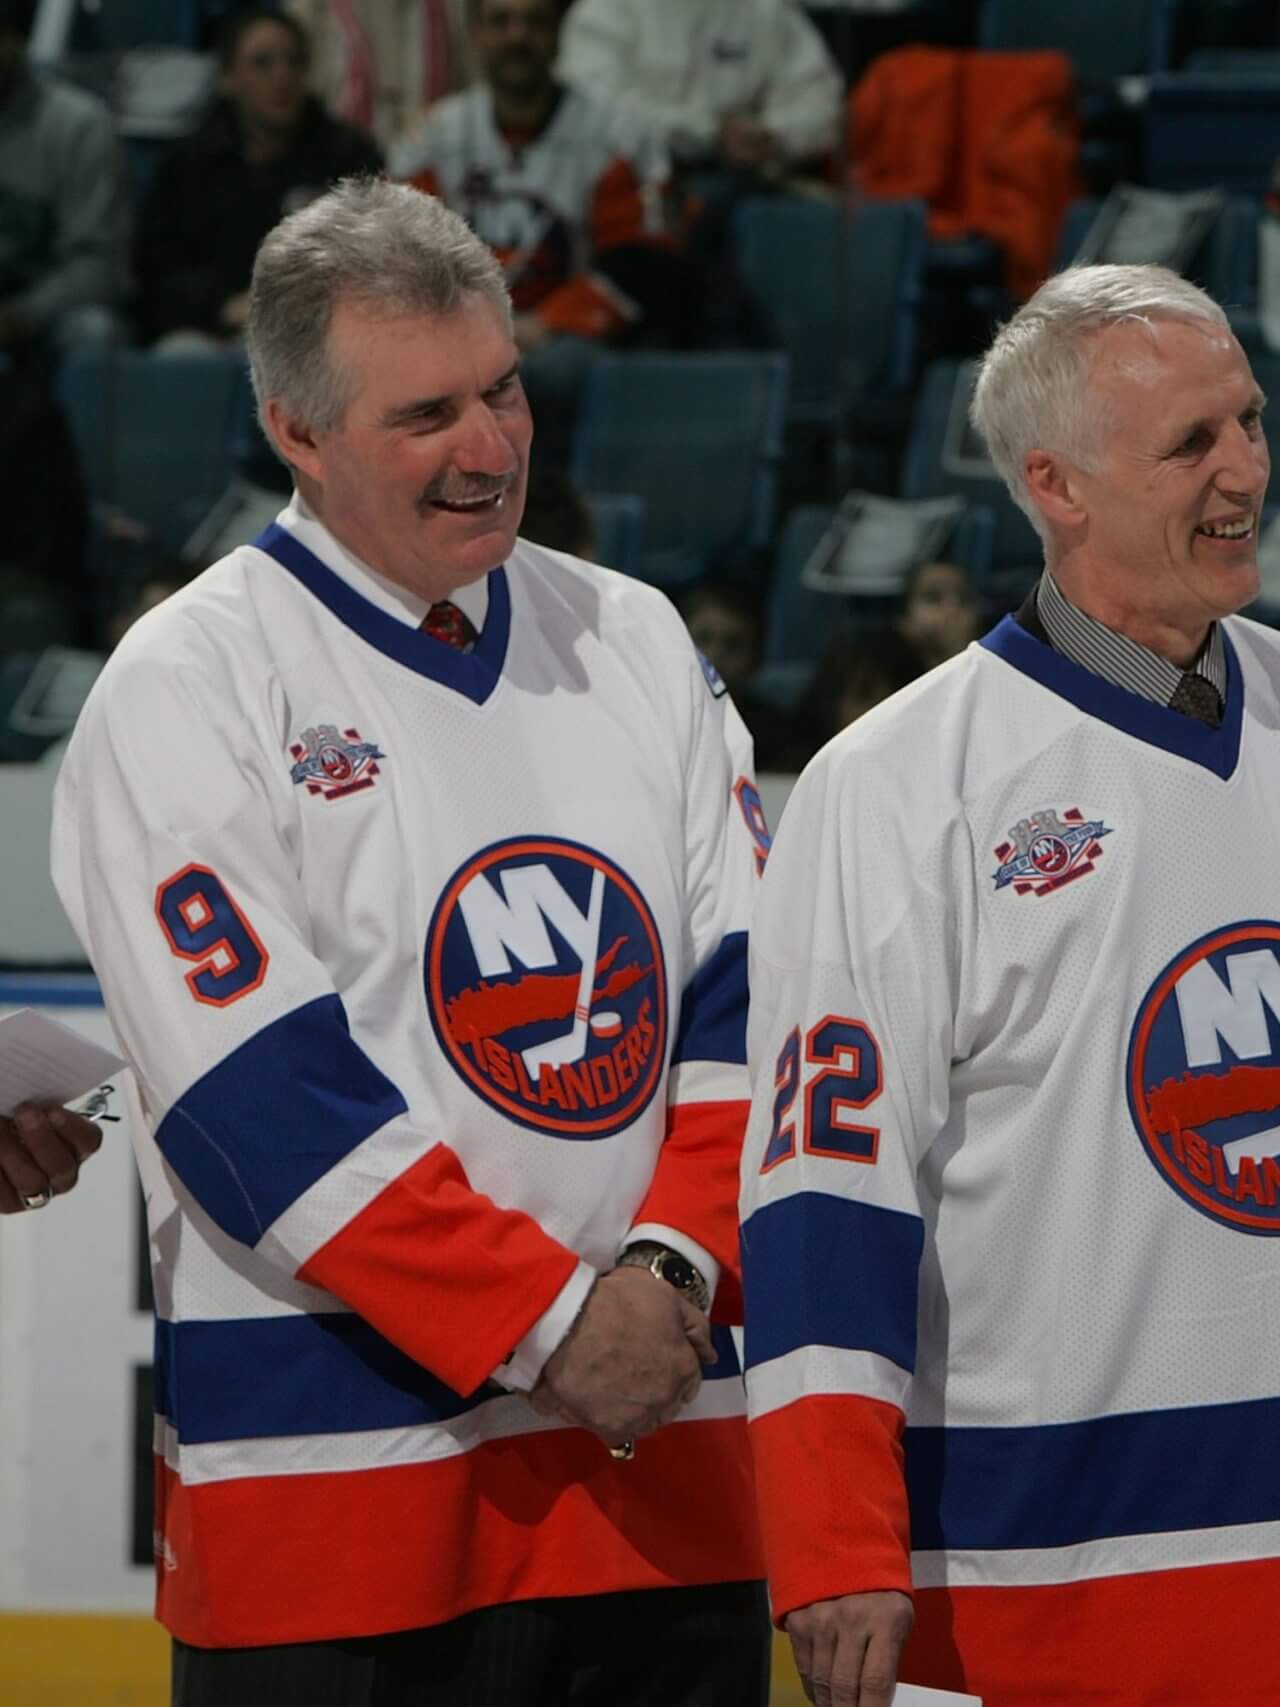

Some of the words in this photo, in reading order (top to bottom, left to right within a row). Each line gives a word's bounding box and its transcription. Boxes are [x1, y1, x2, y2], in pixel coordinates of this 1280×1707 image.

[155, 862, 269, 1008] 9
[457, 863, 606, 978] NY
[467, 996, 656, 1110] ISLANDERS
[758, 1014, 884, 1176] 22
